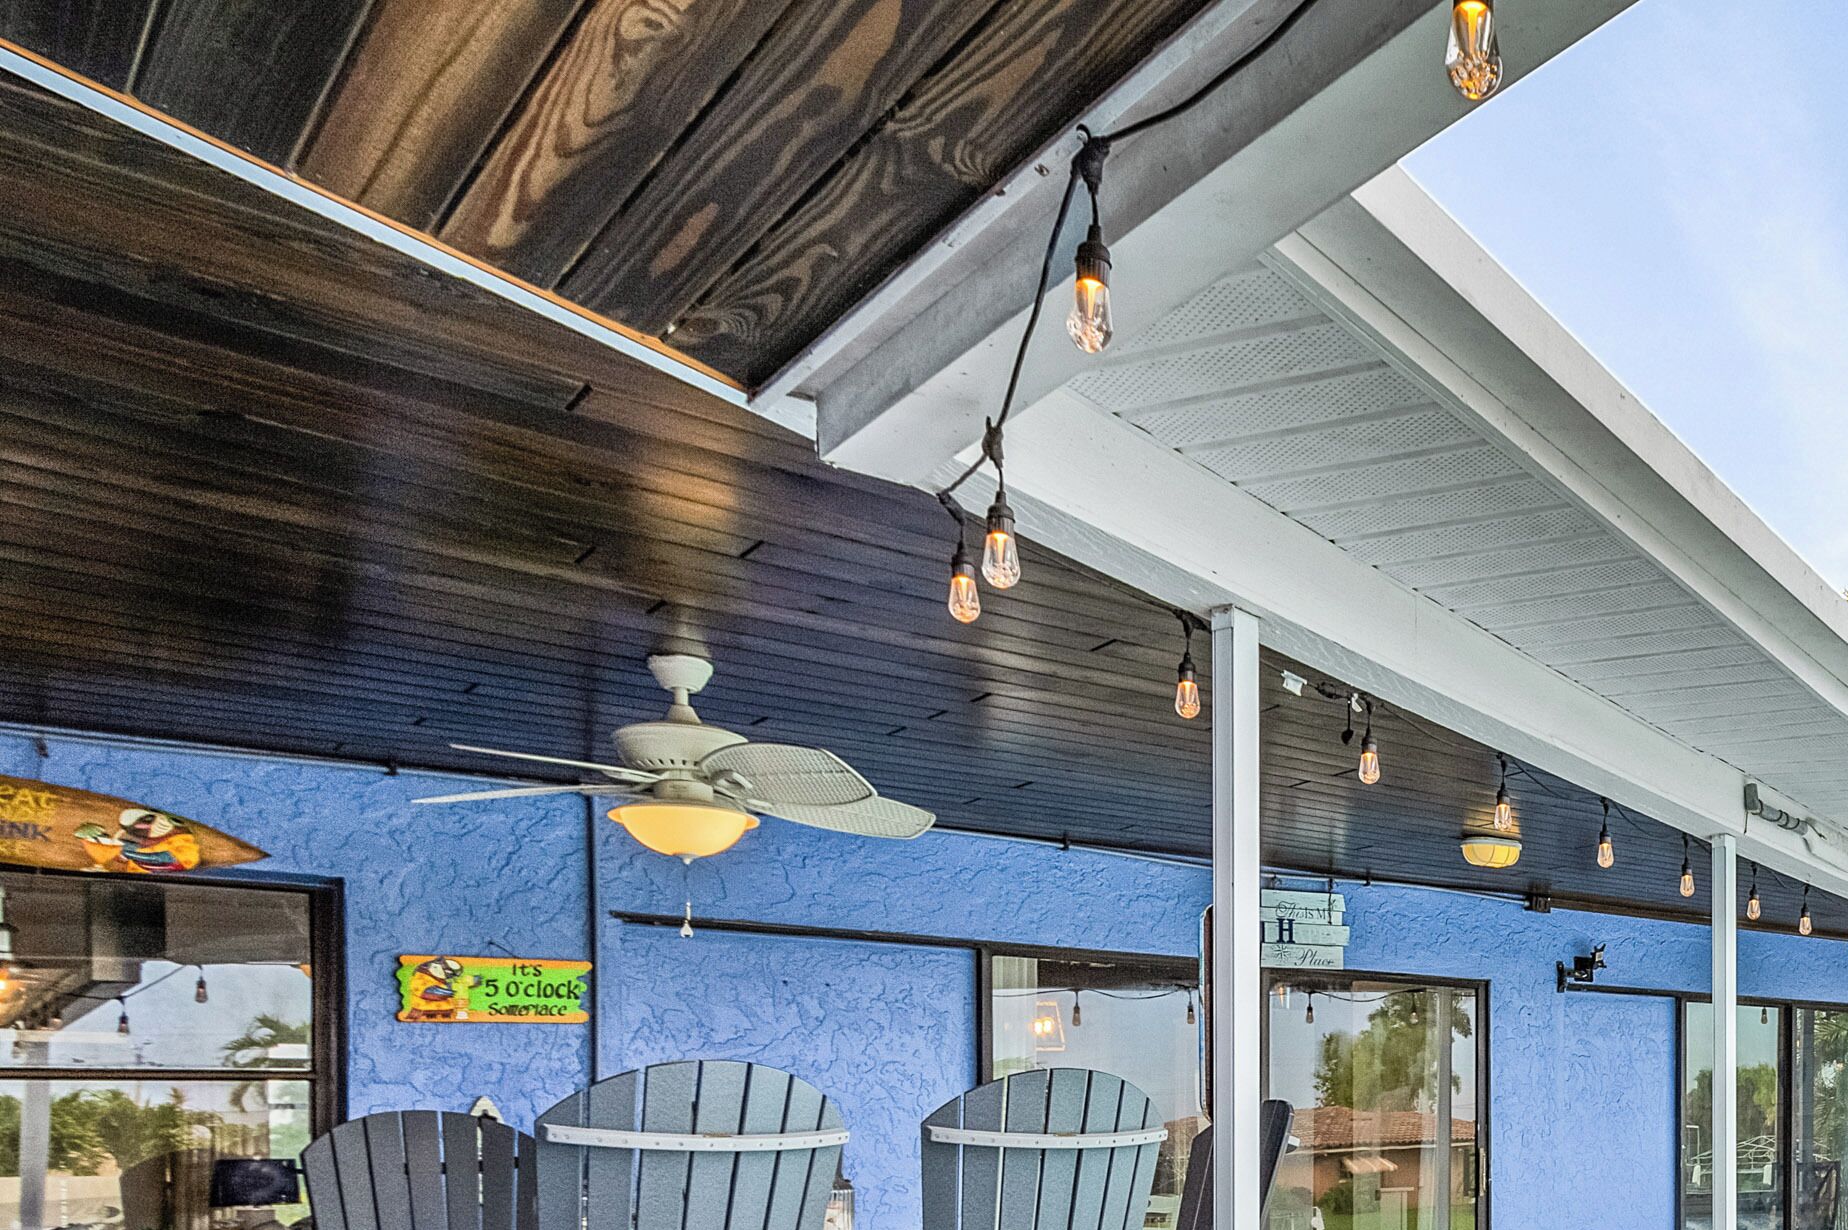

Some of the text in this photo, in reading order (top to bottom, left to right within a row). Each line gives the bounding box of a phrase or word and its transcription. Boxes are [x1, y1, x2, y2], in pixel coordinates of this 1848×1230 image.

[1294, 948, 1335, 967] Place
[484, 979, 580, 1000] 5 O'clock
